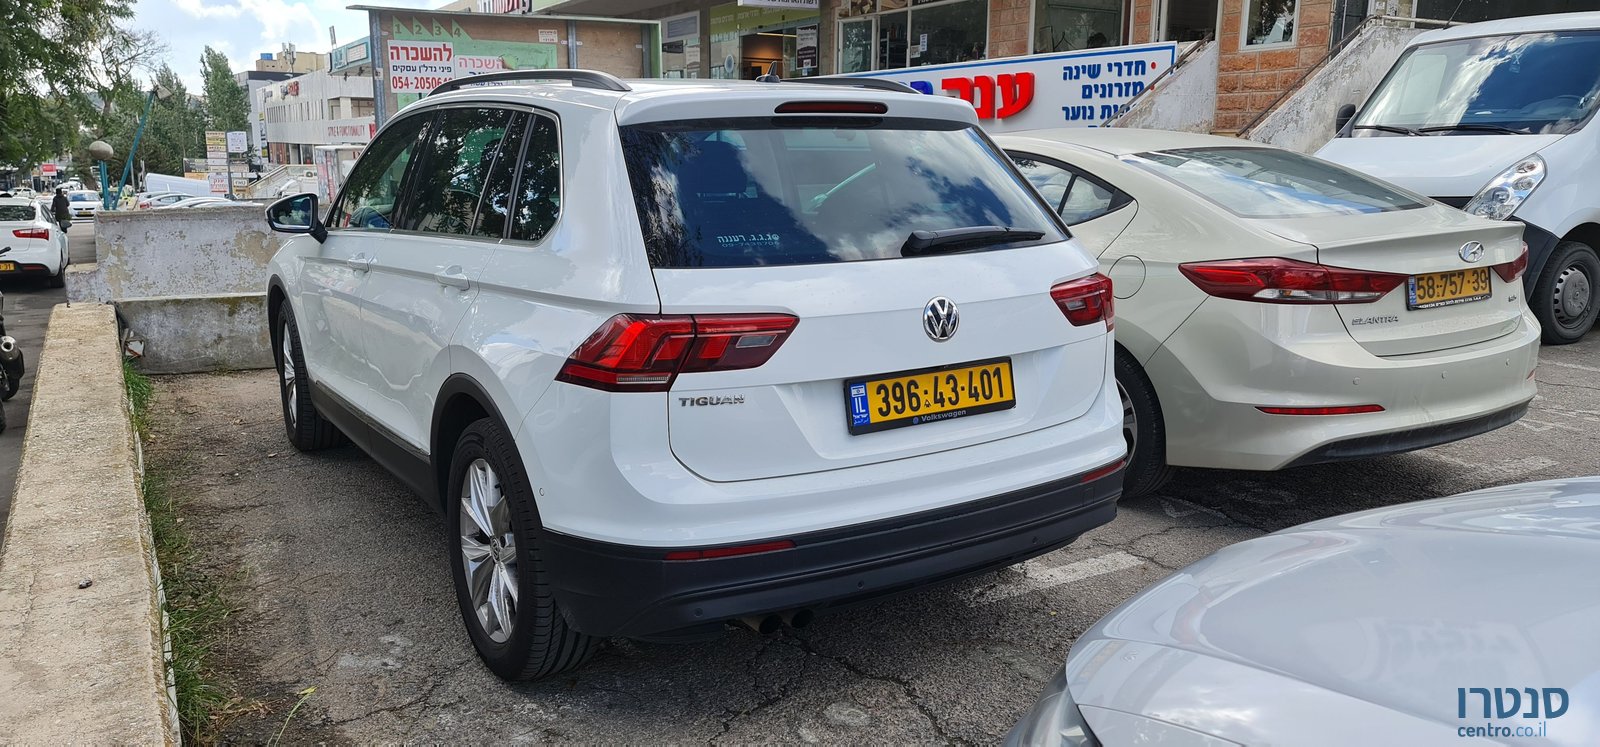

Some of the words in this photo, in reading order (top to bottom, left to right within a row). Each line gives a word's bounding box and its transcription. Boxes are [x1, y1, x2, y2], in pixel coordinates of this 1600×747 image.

[395, 24, 401, 34] 1
[415, 25, 422, 35] 2
[434, 26, 441, 36] 3
[453, 27, 461, 37] 4
[390, 43, 452, 62] להשכרה
[392, 65, 417, 73] עסקים
[438, 65, 452, 73] פיני
[1062, 63, 1101, 81] שינה
[1107, 60, 1147, 77] חדרי
[392, 76, 452, 90] 054-20506
[1081, 81, 1145, 100] מזרונים
[1062, 105, 1095, 121] נוער
[717, 235, 746, 243] רעננה
[1352, 316, 1399, 326] ELANTRA
[679, 394, 745, 407] TIGUAN
[854, 397, 866, 414] IL
[921, 409, 967, 422] Volkswagen
